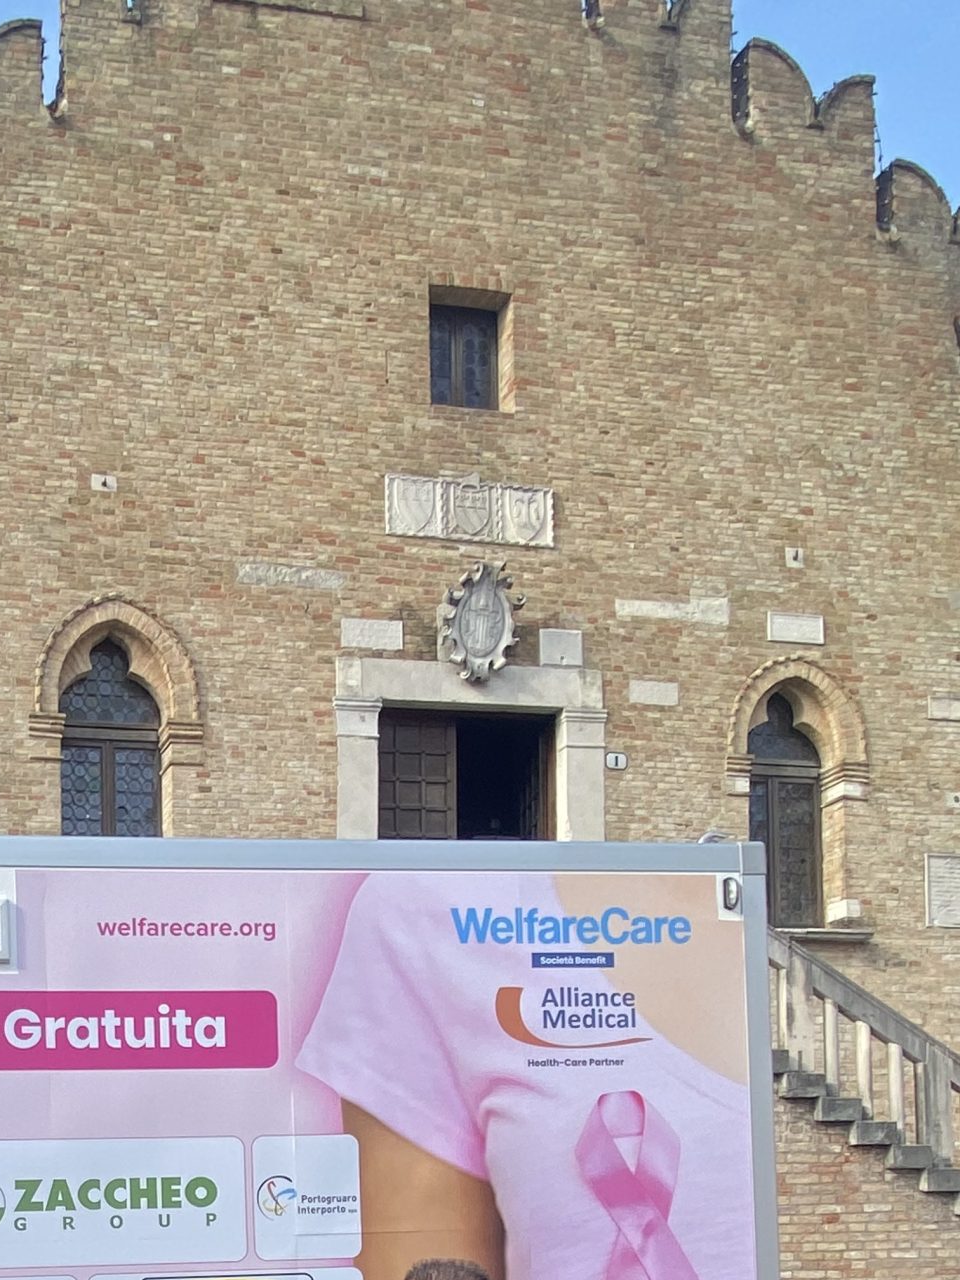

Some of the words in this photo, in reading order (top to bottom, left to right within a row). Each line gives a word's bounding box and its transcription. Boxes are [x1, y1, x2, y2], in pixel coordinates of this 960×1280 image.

[97, 916, 277, 942] welfarecare.org
[450, 906, 692, 945] WelfareCare
[539, 955, 574, 965] Società
[575, 955, 607, 965] Benefit
[541, 987, 635, 1008] Alliance
[4, 1003, 227, 1050] Gratuita
[542, 1008, 637, 1029] Medical
[527, 1058, 587, 1068] Health-Care
[589, 1057, 625, 1067] Partner
[14, 1176, 218, 1213] ZACCHEO
[300, 1194, 357, 1205] Portogruaro
[297, 1205, 346, 1216] Interporto
[14, 1212, 218, 1231] GROUP
